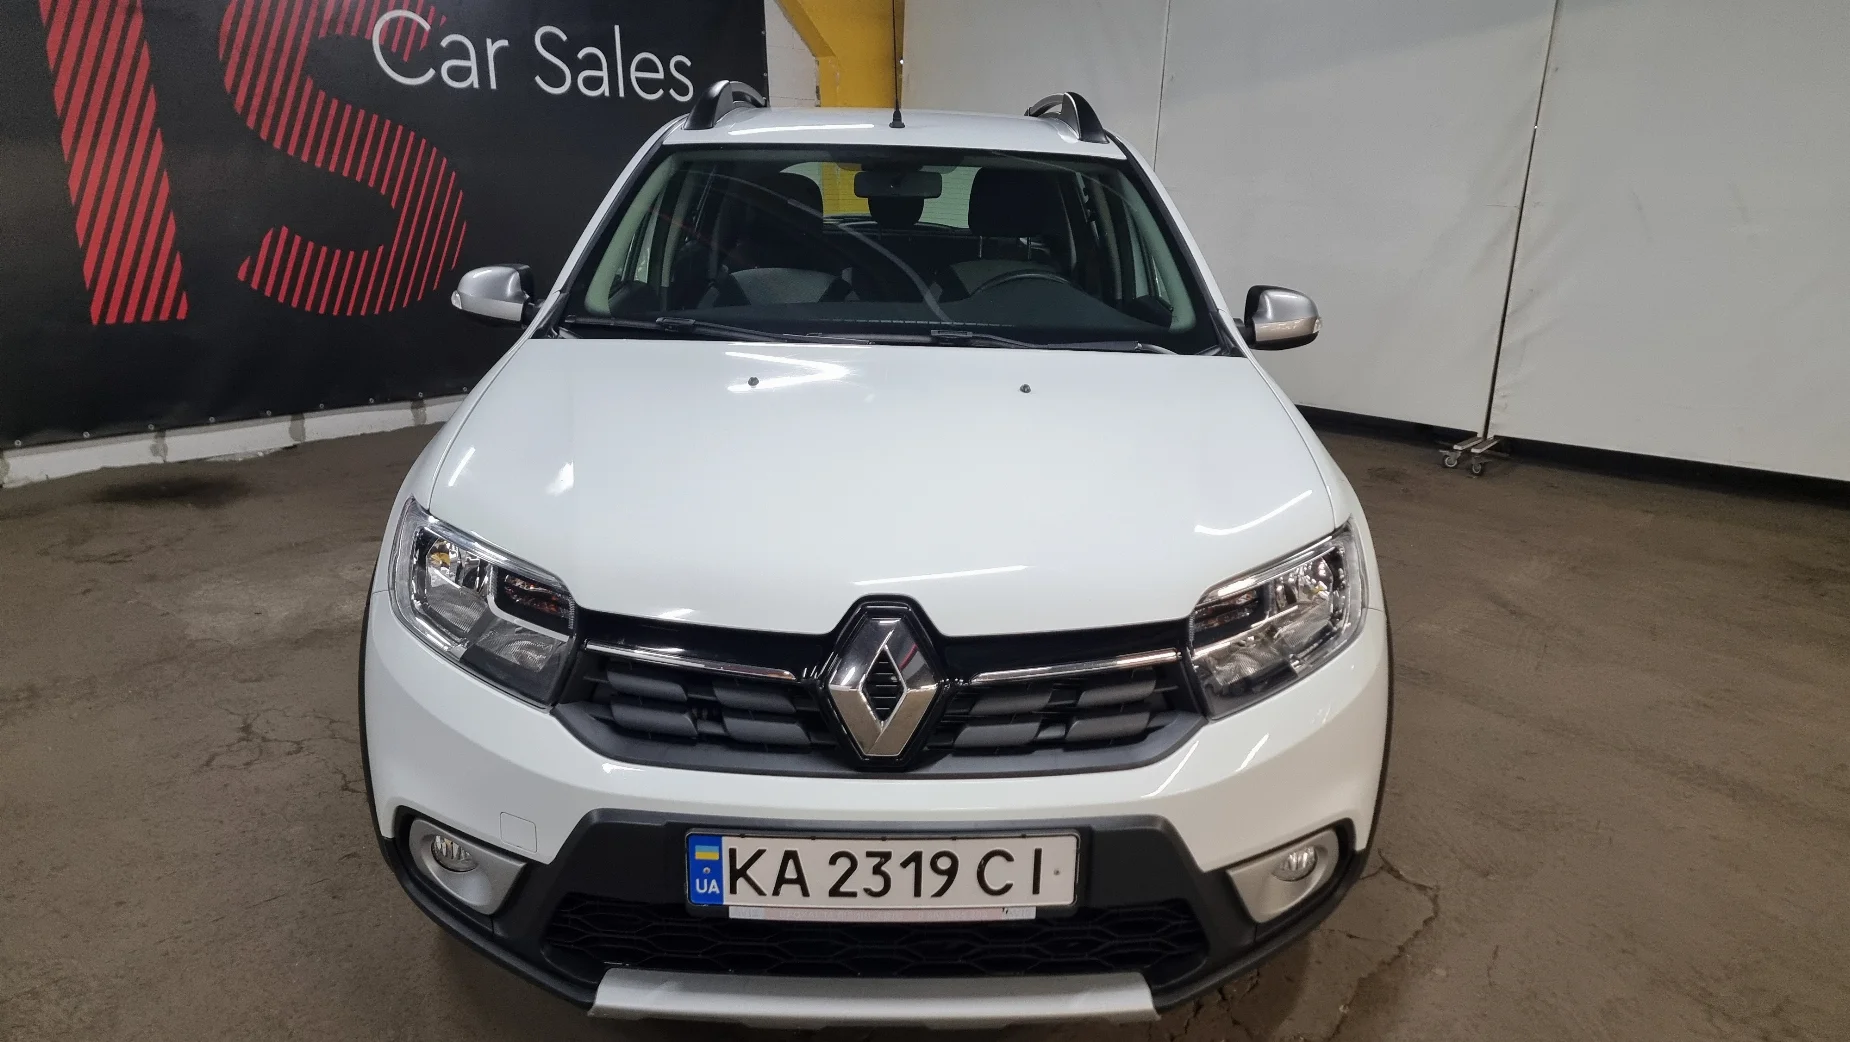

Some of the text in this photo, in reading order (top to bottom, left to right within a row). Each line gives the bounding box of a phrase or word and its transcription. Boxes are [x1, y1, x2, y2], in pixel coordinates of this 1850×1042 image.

[371, 9, 694, 102] Car Sales
[695, 878, 720, 894] UA
[728, 847, 1043, 898] KA 2319 CI
